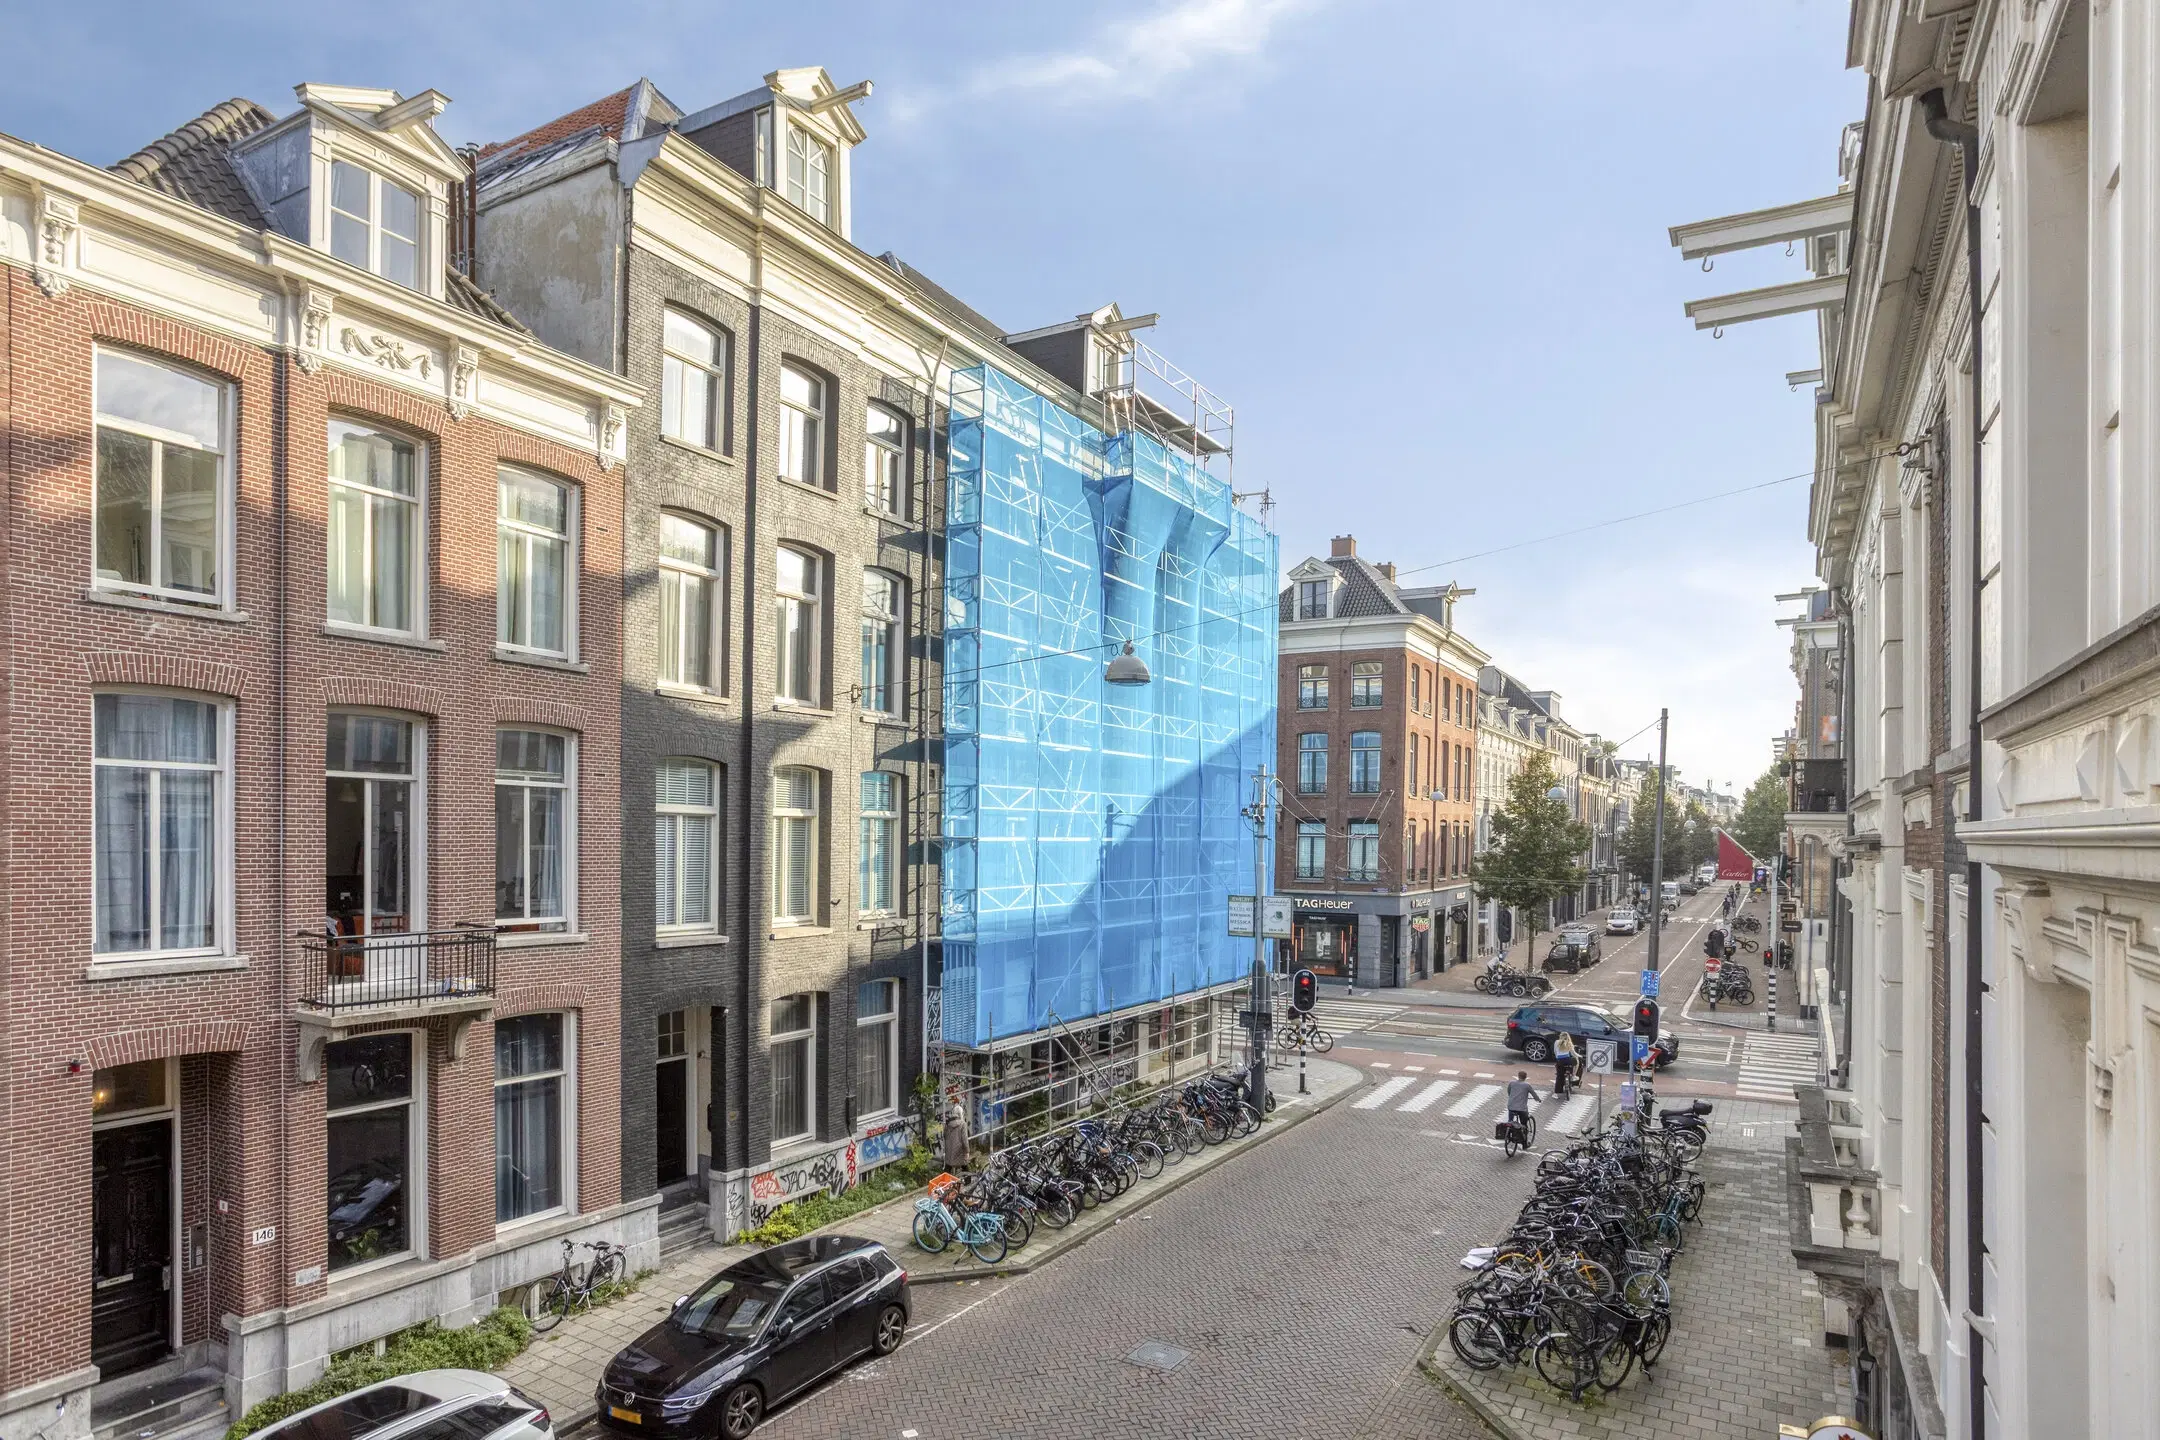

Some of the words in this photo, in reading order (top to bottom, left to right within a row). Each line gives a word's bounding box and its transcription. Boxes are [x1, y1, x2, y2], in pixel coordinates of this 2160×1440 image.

[1722, 868, 1749, 877] Cartier
[1637, 1043, 1644, 1053] P
[255, 1228, 274, 1241] 146
